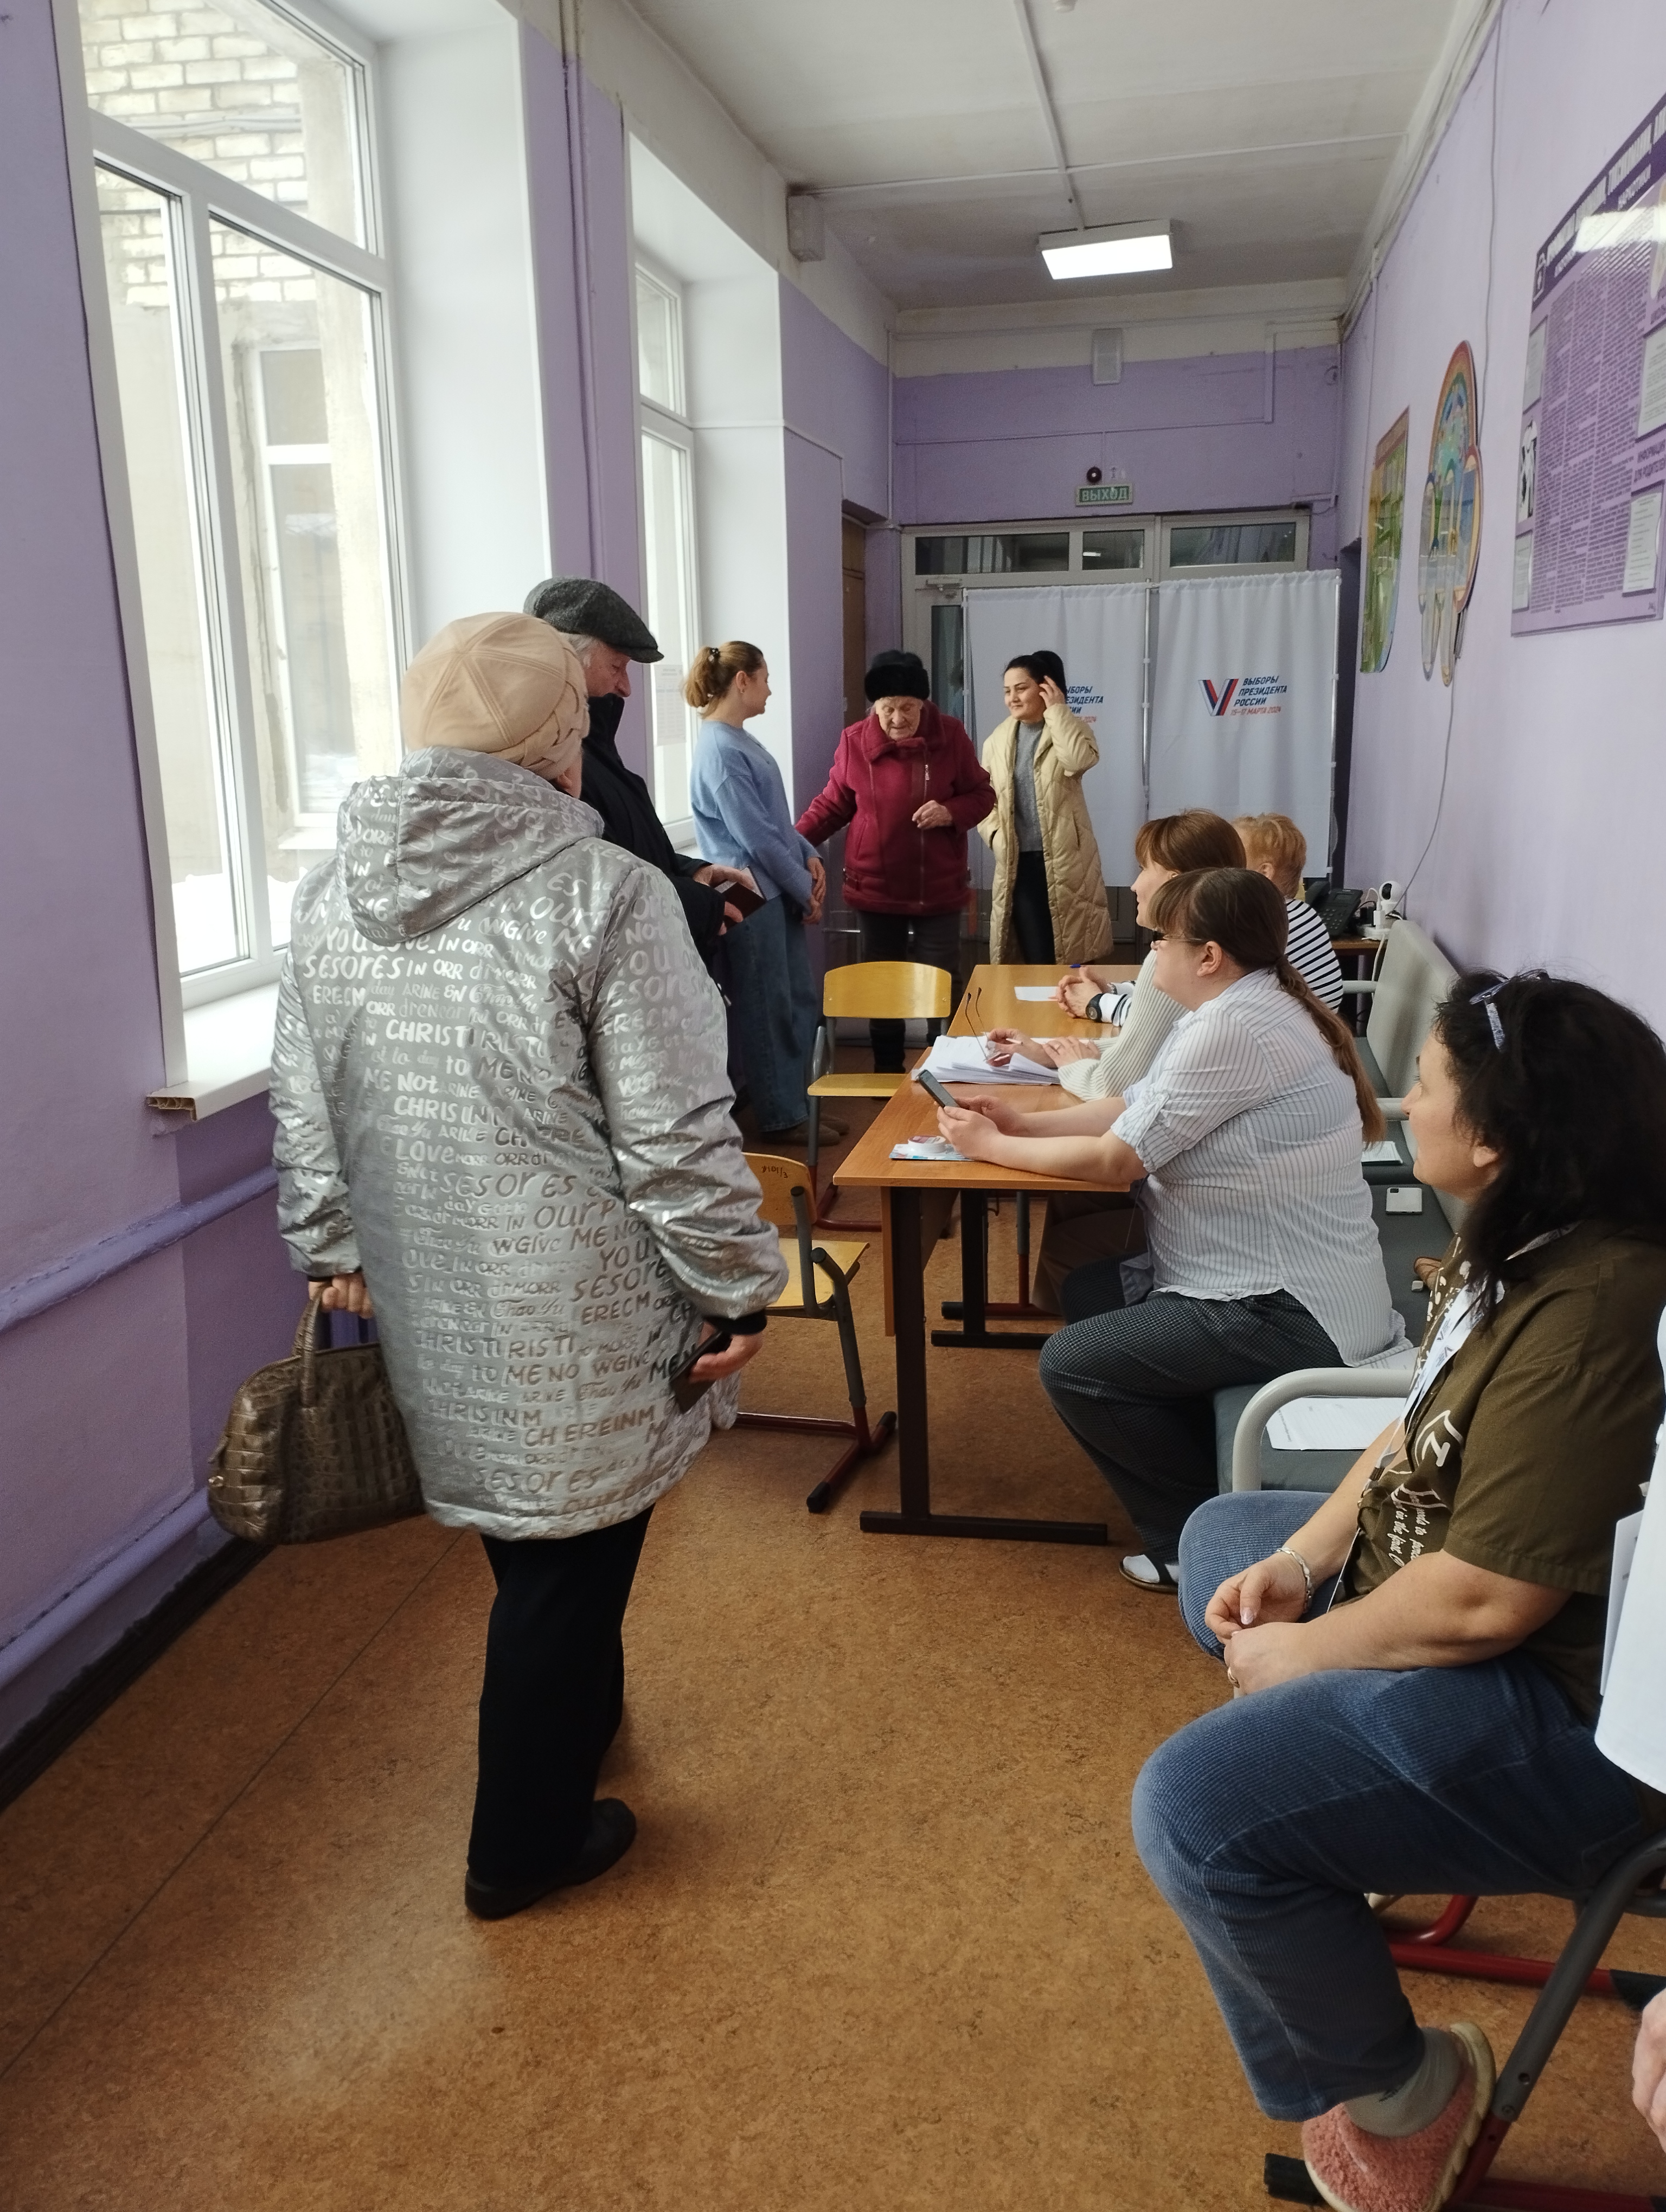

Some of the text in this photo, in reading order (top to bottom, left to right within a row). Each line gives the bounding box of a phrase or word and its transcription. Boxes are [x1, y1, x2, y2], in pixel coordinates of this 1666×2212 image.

[1082, 487, 1127, 501] ВЫХОД
[1242, 676, 1279, 686] ВЫБОРЫ
[1067, 686, 1093, 694] ЫБОРЫ
[1238, 685, 1287, 697] ПРЕЗИДЕНТА
[1066, 696, 1104, 705] ЕЗИДЕНТА
[1234, 697, 1267, 707] РОССИИ
[406, 960, 427, 976] IN
[433, 959, 463, 980] ORR
[366, 1000, 396, 1016] ORR
